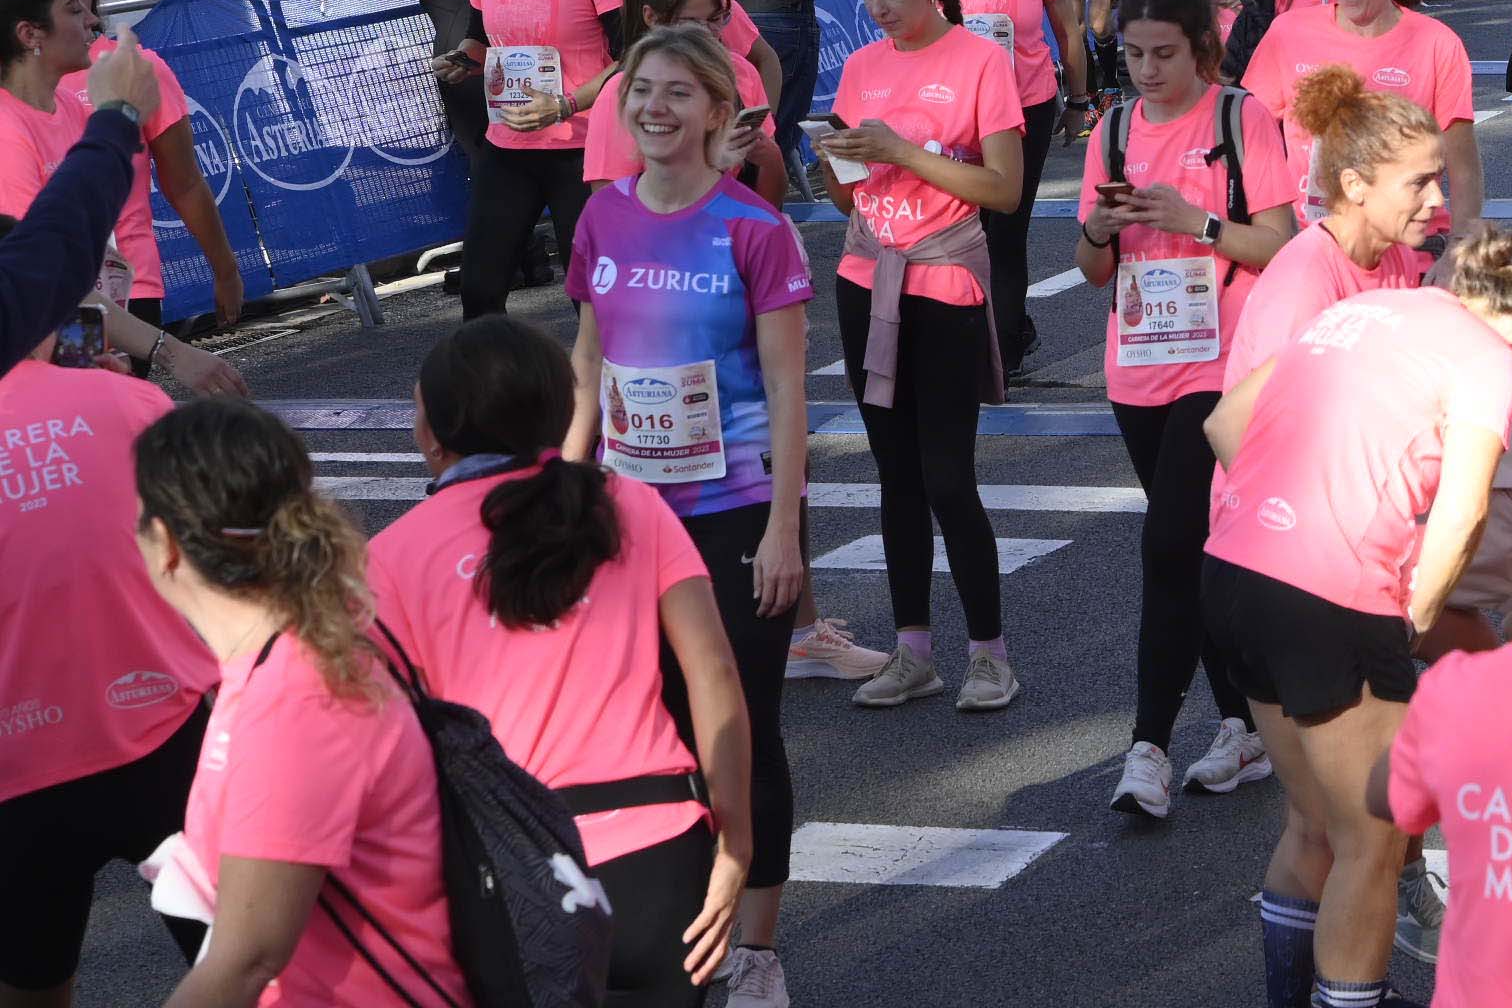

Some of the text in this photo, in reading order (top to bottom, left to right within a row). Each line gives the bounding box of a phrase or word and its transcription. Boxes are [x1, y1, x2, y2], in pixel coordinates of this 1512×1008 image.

[506, 77, 532, 89] 016
[627, 267, 730, 295] ZURICH
[1145, 301, 1179, 317] 016
[1148, 320, 1175, 330] 17640
[631, 413, 674, 430] 016
[637, 434, 670, 445] 17730
[26, 441, 70, 468] LA
[0, 463, 85, 503] UJER
